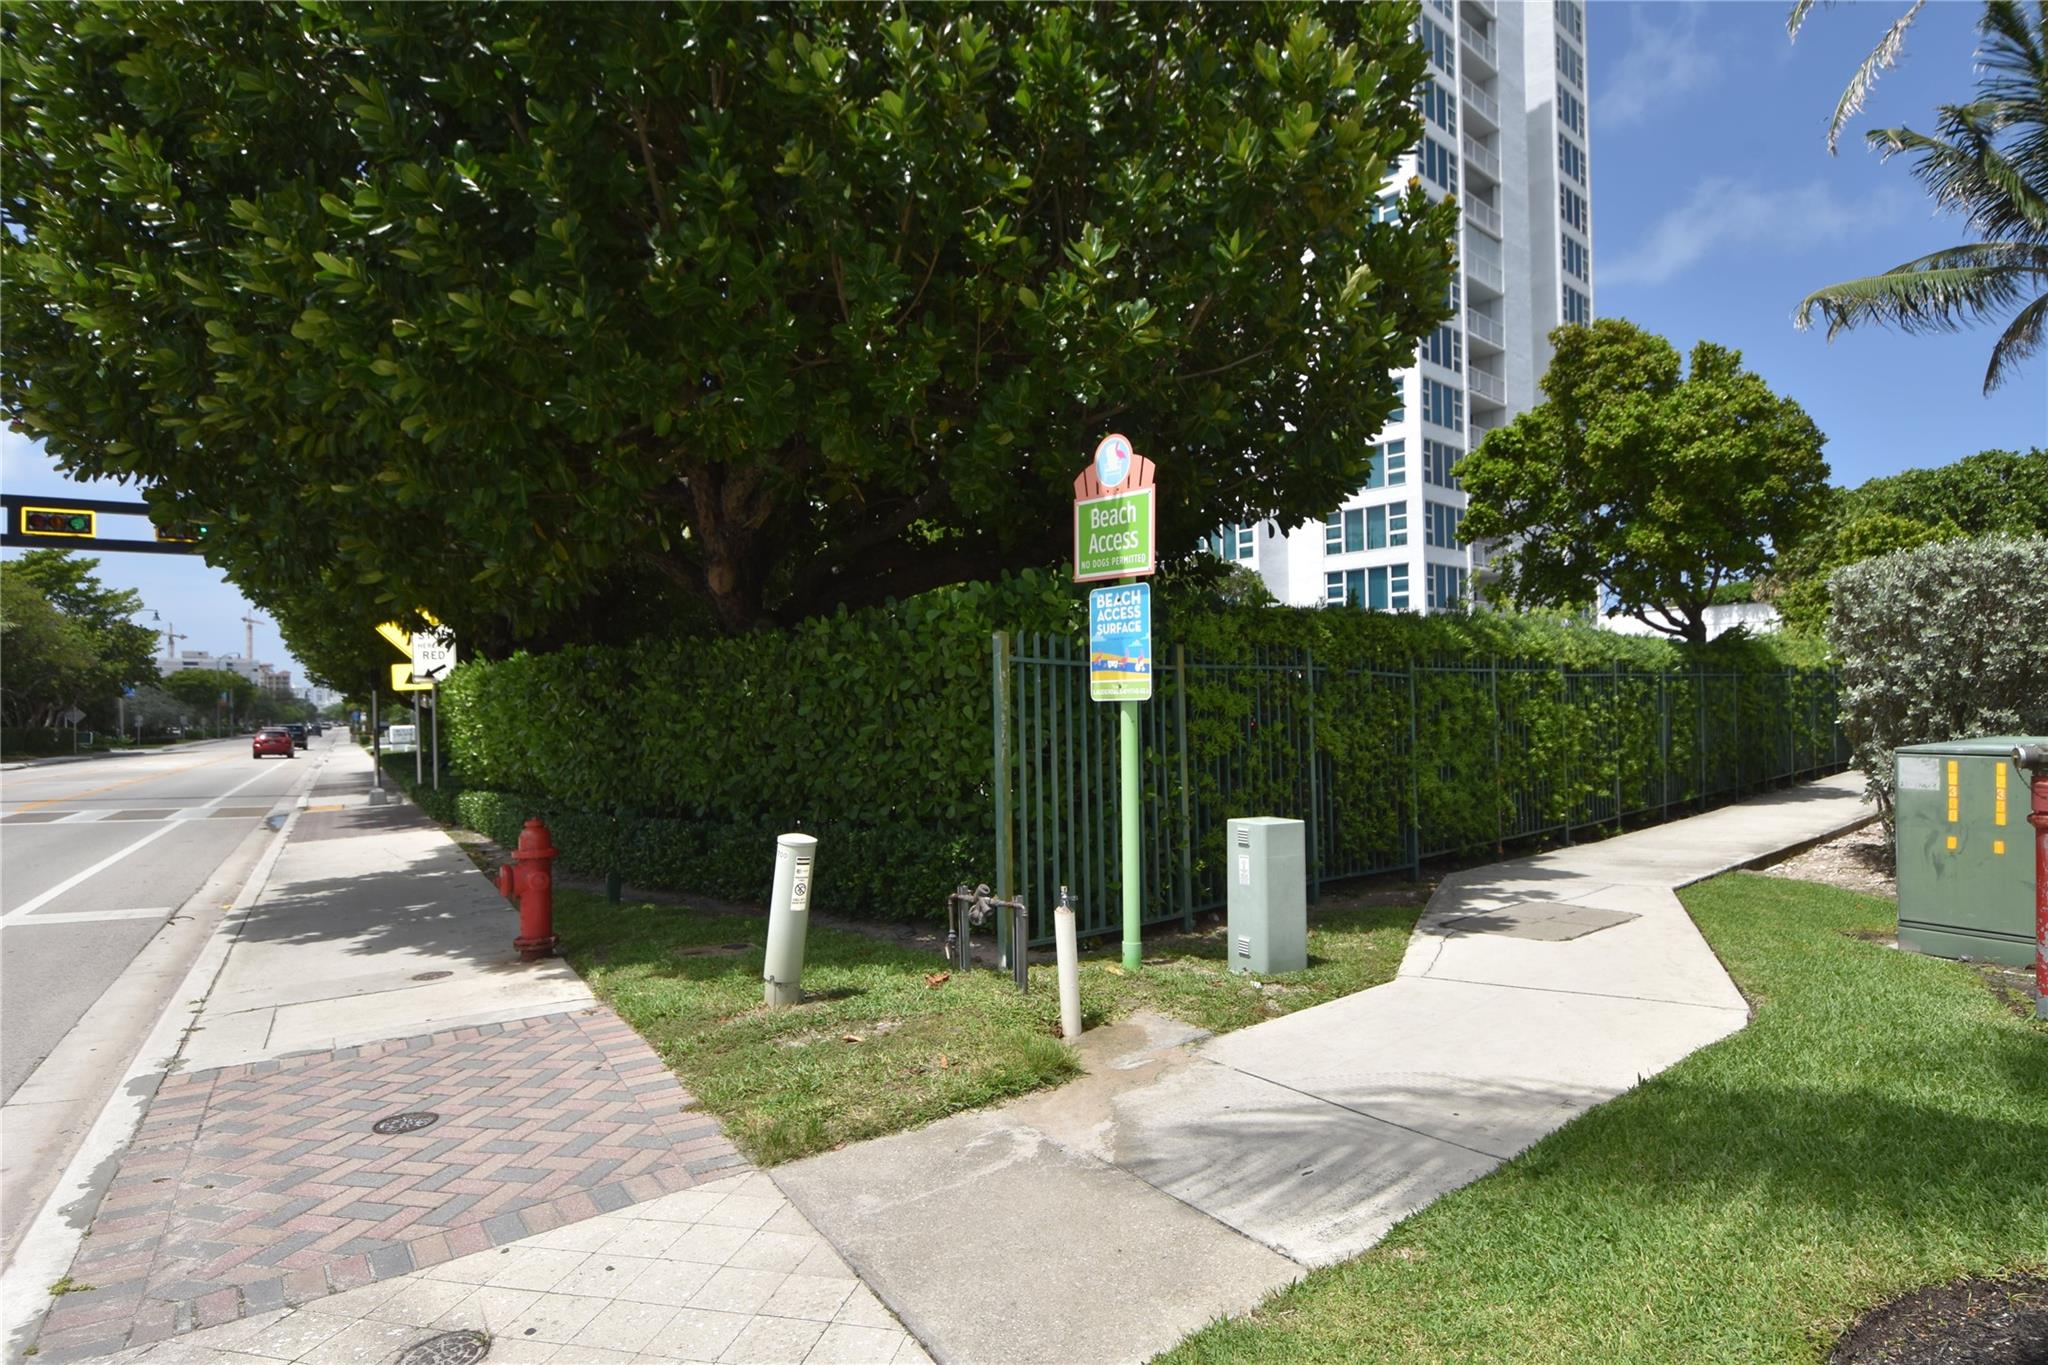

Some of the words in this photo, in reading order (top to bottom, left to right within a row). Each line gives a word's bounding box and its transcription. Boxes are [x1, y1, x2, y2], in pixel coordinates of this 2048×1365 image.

[1091, 501, 1137, 528] Beach
[1088, 530, 1139, 555] Access
[1081, 560, 1091, 569] NO
[1092, 557, 1110, 569] DOGS
[1111, 552, 1146, 566] PERMITTED
[1097, 590, 1141, 608] BEACH
[1097, 606, 1141, 621] ACCESS
[1097, 620, 1141, 634] SURFACE
[423, 651, 445, 660] RED
